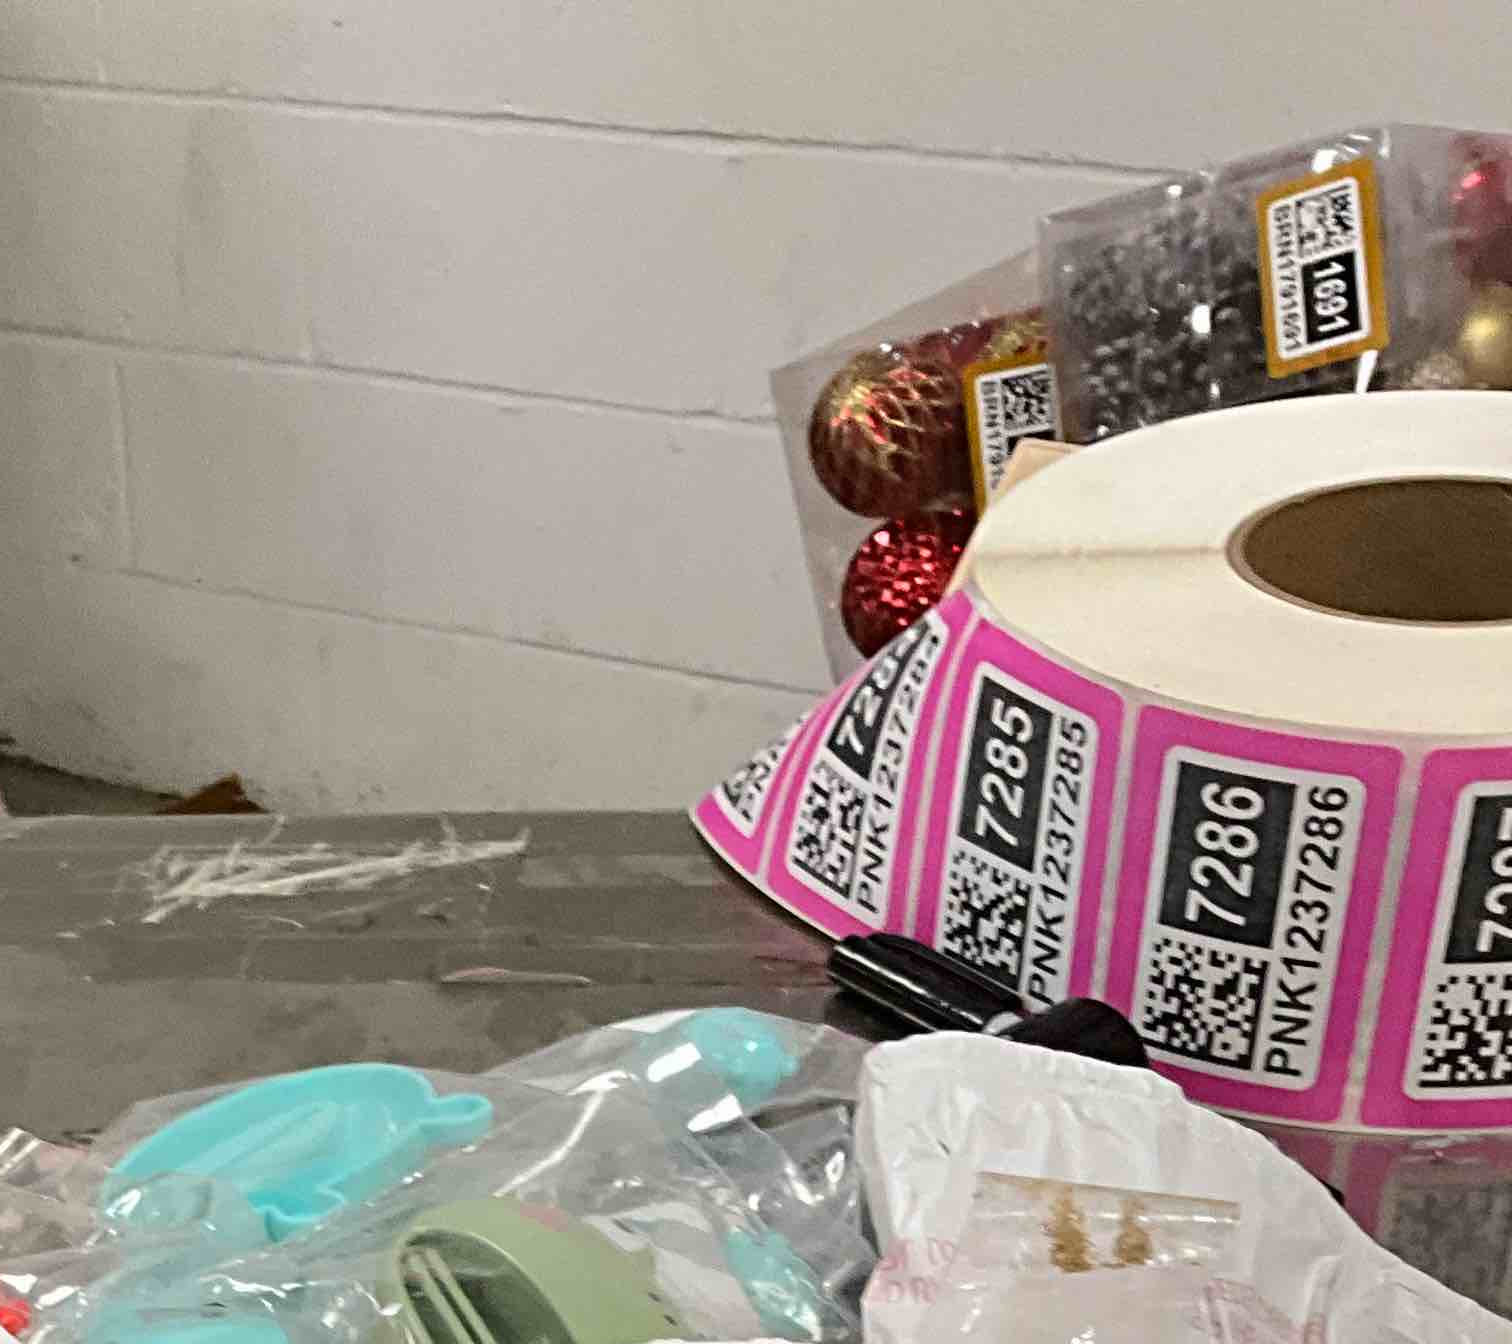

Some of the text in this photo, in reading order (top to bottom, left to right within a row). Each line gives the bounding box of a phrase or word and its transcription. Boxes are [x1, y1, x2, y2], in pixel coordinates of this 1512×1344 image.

[974, 698, 1035, 847] 7285
[1027, 718, 1088, 1006] PNK1237285
[1184, 782, 1266, 927] 7286
[1263, 786, 1350, 1077] PNK1237286
